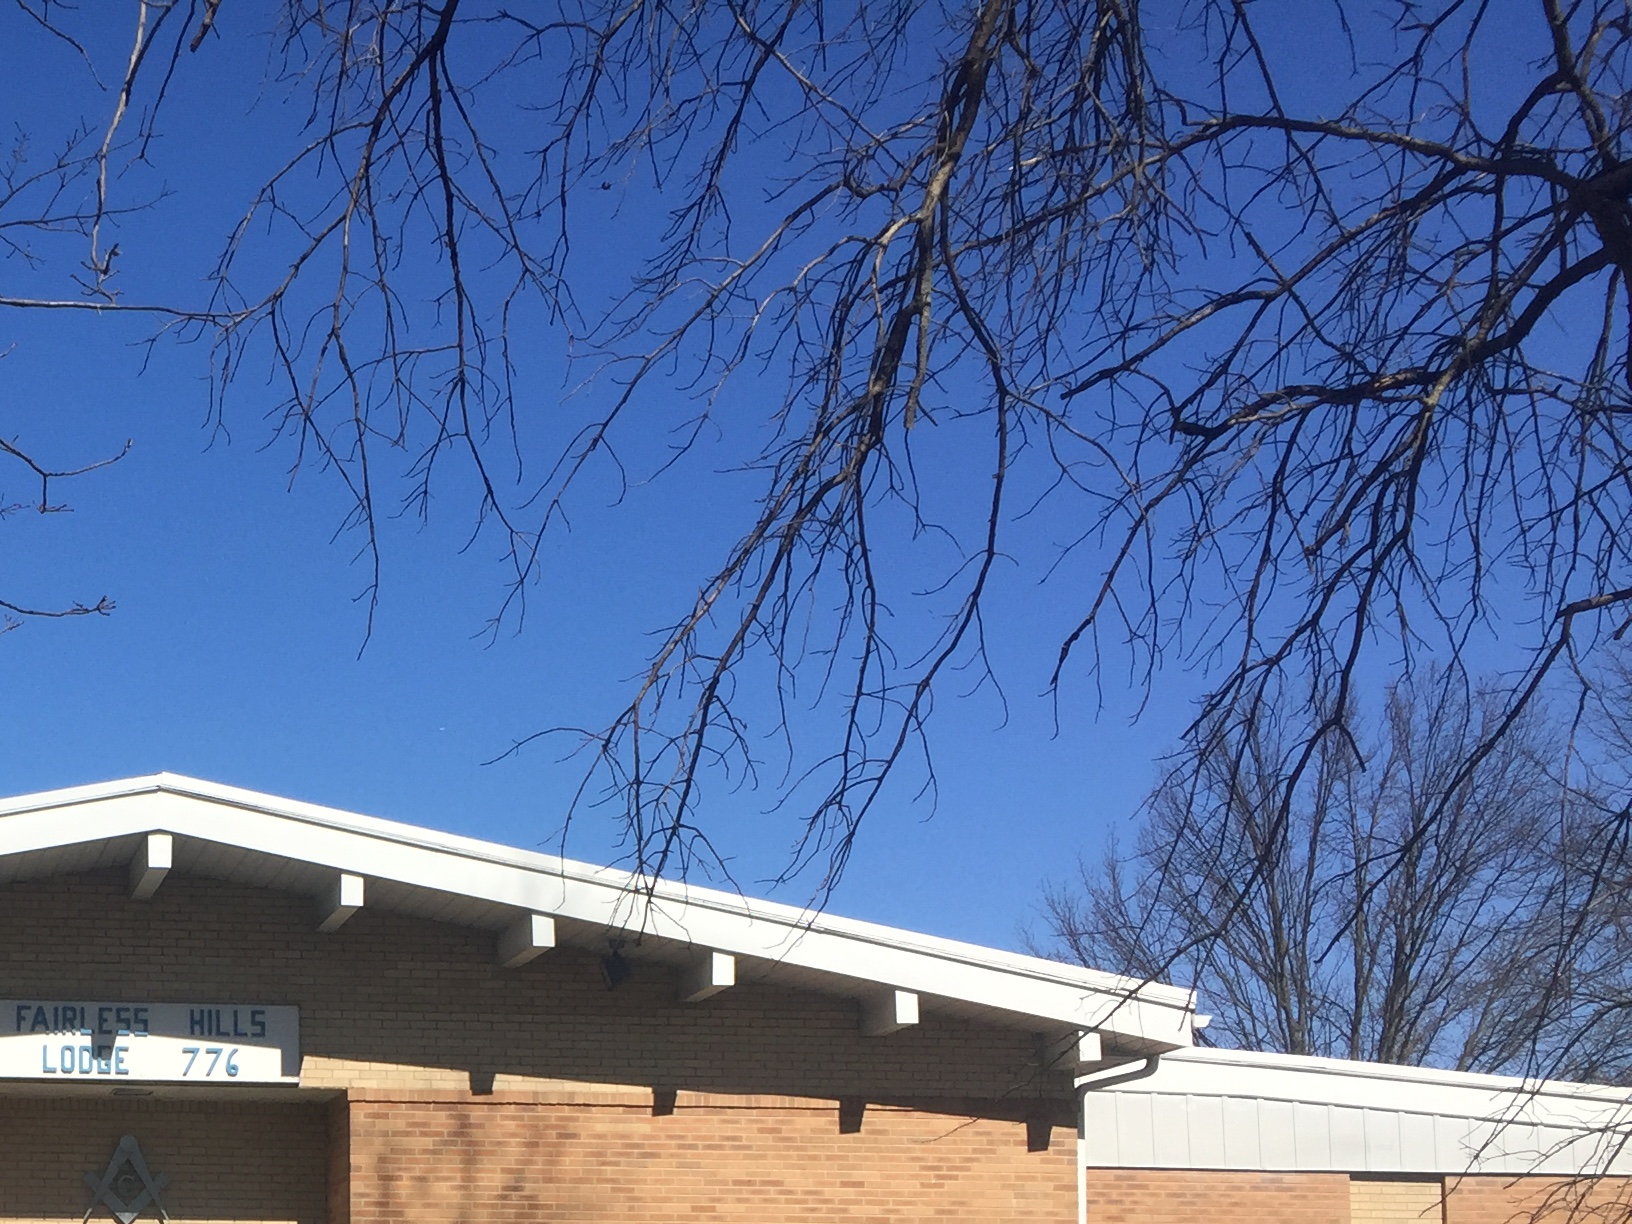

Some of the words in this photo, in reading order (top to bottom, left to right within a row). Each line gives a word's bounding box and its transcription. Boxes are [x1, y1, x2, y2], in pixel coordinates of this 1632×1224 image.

[17, 1005, 149, 1036] FAIRLESS
[189, 1008, 266, 1038] HILLS
[43, 1045, 130, 1075] LODGE
[182, 1047, 240, 1077] 776
